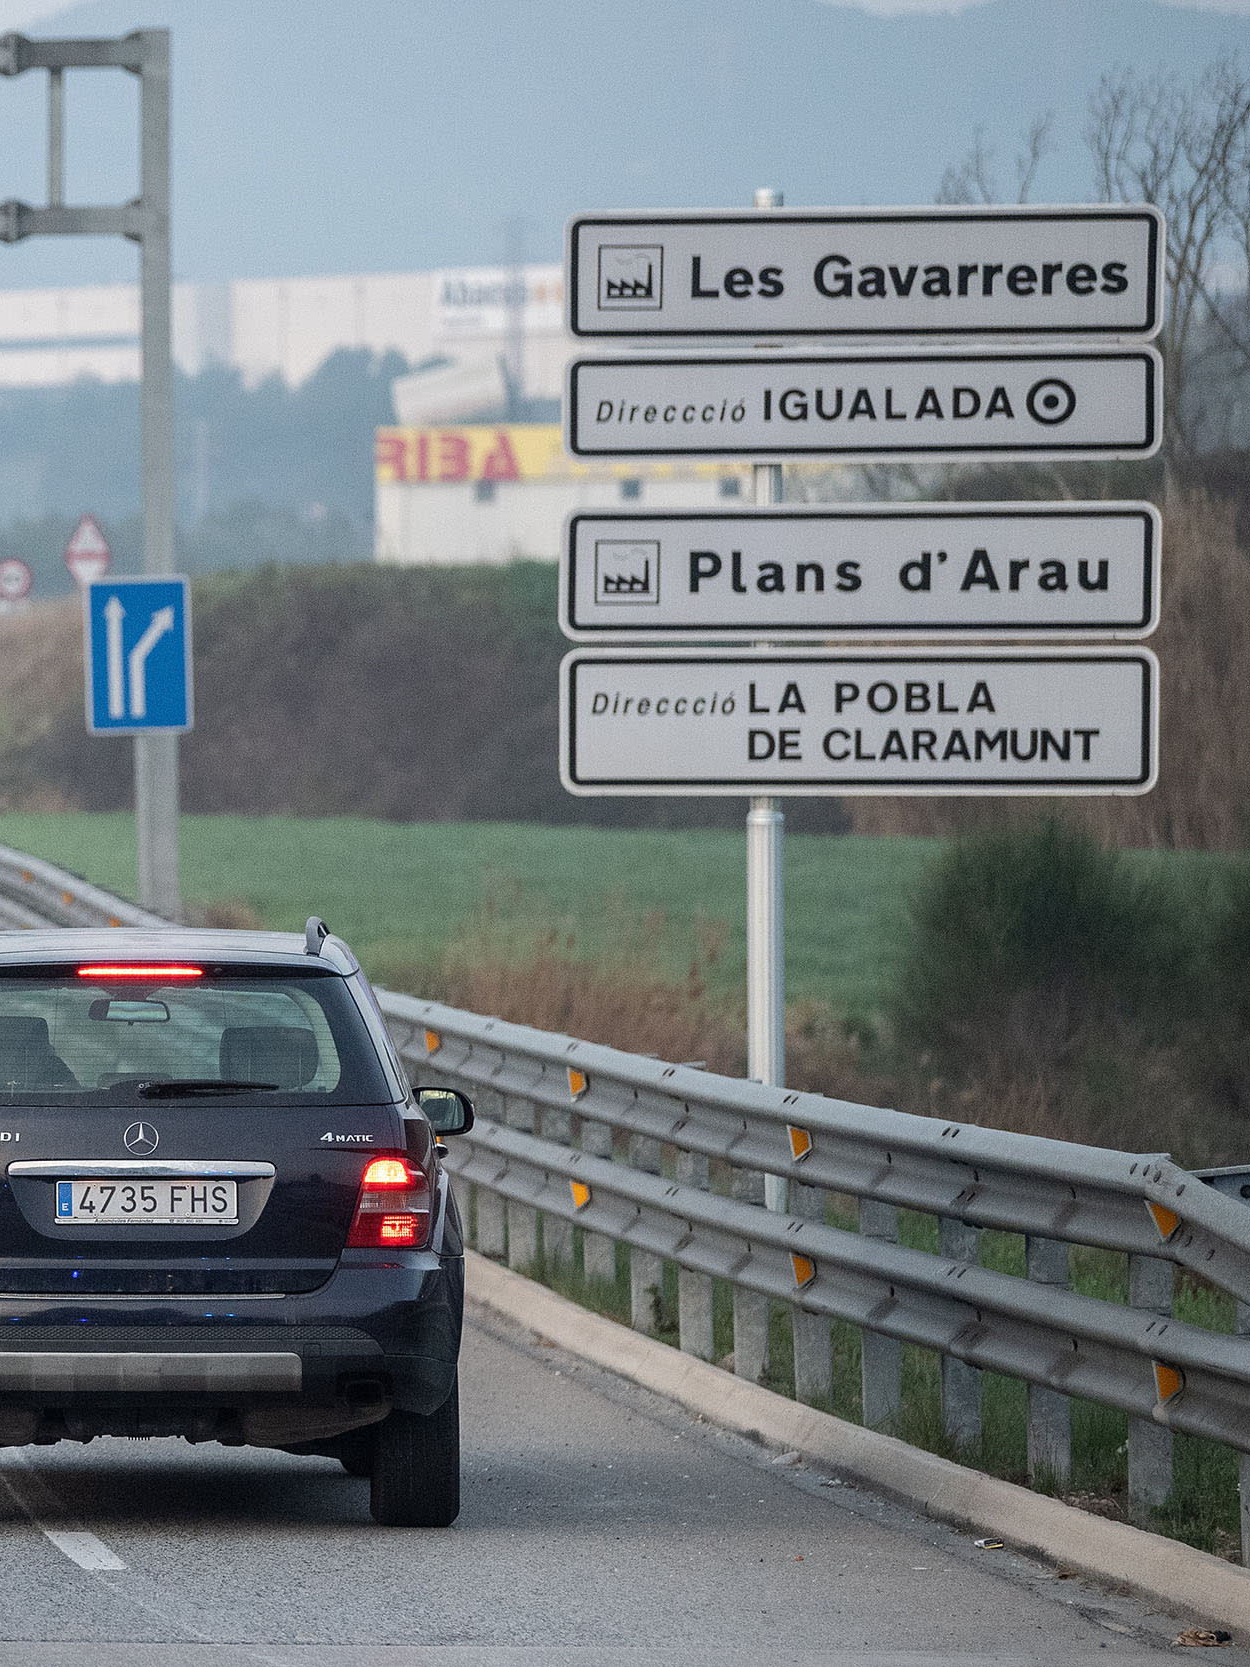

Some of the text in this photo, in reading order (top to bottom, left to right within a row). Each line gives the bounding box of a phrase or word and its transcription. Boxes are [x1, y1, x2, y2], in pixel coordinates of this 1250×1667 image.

[691, 253, 1130, 300] Les Gavarreres
[595, 386, 1015, 425] Direccció IGUALADA
[688, 548, 1110, 595] Plans d'Arau
[590, 680, 996, 717] Direccció LA POBLA
[748, 727, 1101, 762] DE CLARAMUNT
[61, 1202, 69, 1212] E
[79, 1185, 228, 1214] 4735 FHS
